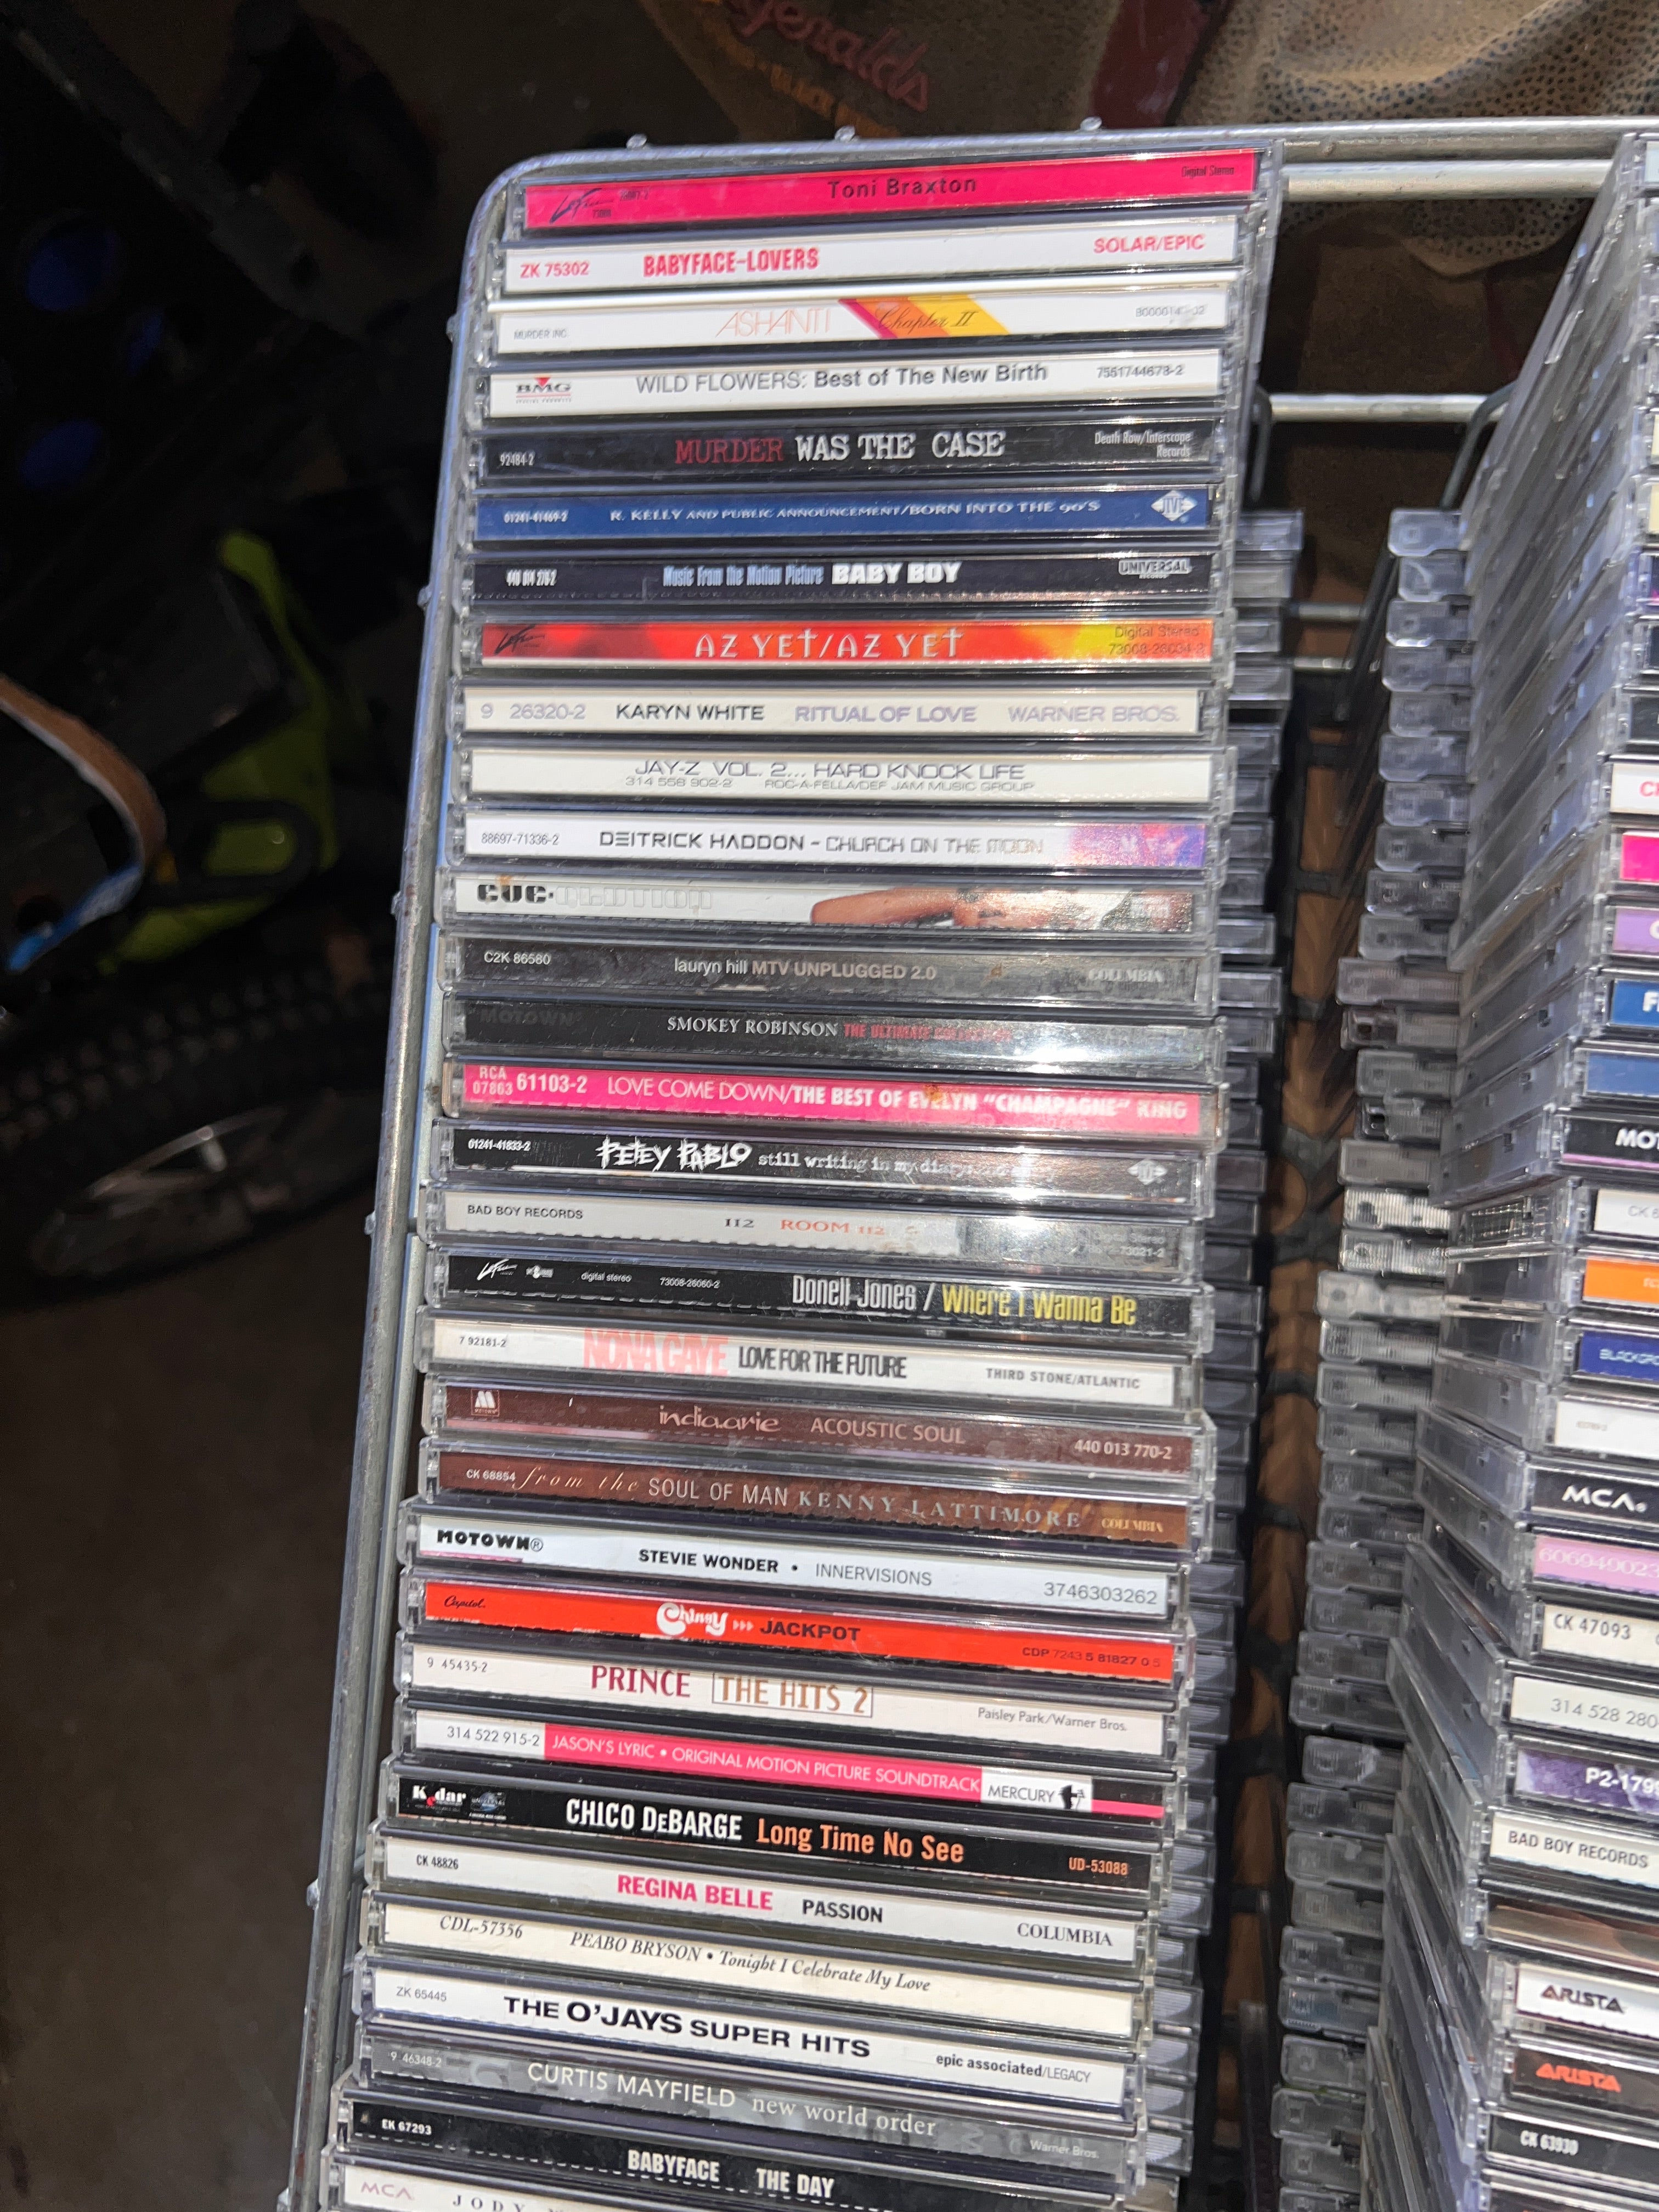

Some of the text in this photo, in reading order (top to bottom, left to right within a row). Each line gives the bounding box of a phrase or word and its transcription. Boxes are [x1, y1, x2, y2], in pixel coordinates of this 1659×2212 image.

[828, 177, 977, 199] Toni Braxton
[1094, 234, 1205, 253] SOLAR/EPIC
[520, 262, 589, 278] ZK 75302
[644, 249, 820, 276] BABYFACE-LOVERS
[636, 364, 1049, 393] WILD FLOWERS: Best of The New Birth
[1097, 365, 1184, 378] 7551744678-2
[675, 431, 1006, 464] MURDER WAS THE CASE
[1095, 430, 1192, 445] Death Row/Interscope
[500, 452, 535, 466] 92484-2
[1156, 445, 1190, 458] Records
[610, 510, 626, 521] R.
[631, 509, 680, 521] KELLY
[686, 510, 718, 519] AND
[721, 509, 773, 519] PUBLIC
[776, 504, 961, 518] ANNOUNCEMENT/BORN
[966, 502, 1013, 514] INTO
[1019, 501, 1054, 512] THE
[1114, 627, 1199, 639] Digital Stereo
[481, 703, 586, 720] 9 26320-2
[616, 704, 765, 720] KARYN WHITE
[794, 706, 978, 723] RITUAL OF LOVE
[1009, 706, 1181, 723] WARNER BROS.
[635, 760, 1025, 780] JAY-Z VOL. 2... HARD KNOCK LIFE
[481, 833, 560, 845] 88697-71336-2
[599, 831, 702, 849] DEITRICK
[710, 833, 804, 850] HADDON
[826, 836, 905, 853] CHURCH
[911, 838, 938, 852] ON
[944, 838, 981, 853] THE
[484, 952, 551, 965] C2K 86580
[674, 958, 936, 981] lauryn hill MTV UNPLUGGED 2.0
[478, 1066, 507, 1080] RCA
[472, 1073, 588, 1096] 07863 61103-2
[607, 1077, 654, 1097] LOVE
[657, 1079, 713, 1099] COME
[719, 1081, 825, 1106] DOWN/THE
[831, 1088, 873, 1107] BEST
[878, 1089, 902, 1107] OF
[908, 1090, 977, 1111] EVELYN
[1137, 1103, 1187, 1120] KING
[467, 1205, 584, 1220] BAD BOY RECORDS
[581, 1272, 633, 1283] digital stereo
[811, 1418, 966, 1445] ACOUSTIC SOUL
[512, 1466, 1082, 1527] from the SOUL OF MAN KENNY LATTIMORE
[1562, 1485, 1635, 1512] MCA
[639, 1549, 778, 1573] STEVIE WONDER
[815, 1563, 933, 1586] INNERVISIONS
[1043, 1582, 1158, 1605] 3746303262
[1554, 1613, 1630, 1640] CK 47093
[427, 1657, 488, 1673] 9 45435-2
[591, 1664, 868, 1713] PRINCE THE HITS 2
[1551, 1699, 1582, 1716] 314
[1588, 1705, 1620, 1722] 528
[447, 1725, 540, 1747] 314 522 915-2
[552, 1736, 1056, 1804] JASON'S LYRIC ORIGINAL MOTION PICTURE SOUNDTRACK MERCURY
[1508, 1830, 1650, 1868] BAD BOY RECORDS
[416, 1854, 459, 1870] CK 48826
[1069, 1857, 1129, 1877] UD-53088
[617, 1875, 883, 1923] REGINA BELLE PASSION
[439, 1915, 523, 1939] CDL-57356
[1017, 1923, 1113, 1946] COLUMBIA
[396, 1986, 447, 2002] ZK 65445
[1540, 1985, 1626, 2015] ARISTA
[503, 1996, 870, 2058] THE O'JAYS SUPER HITS
[936, 2053, 1091, 2084] epic associated/LEGACY
[1536, 2063, 1621, 2093] ARISTA
[527, 2062, 936, 2135] CURTIS MAYFIELD new world order
[382, 2119, 432, 2135] EK 67293
[1030, 2140, 1099, 2158] Warner Bros.
[628, 2149, 834, 2198] BABYFACE THE DAY
